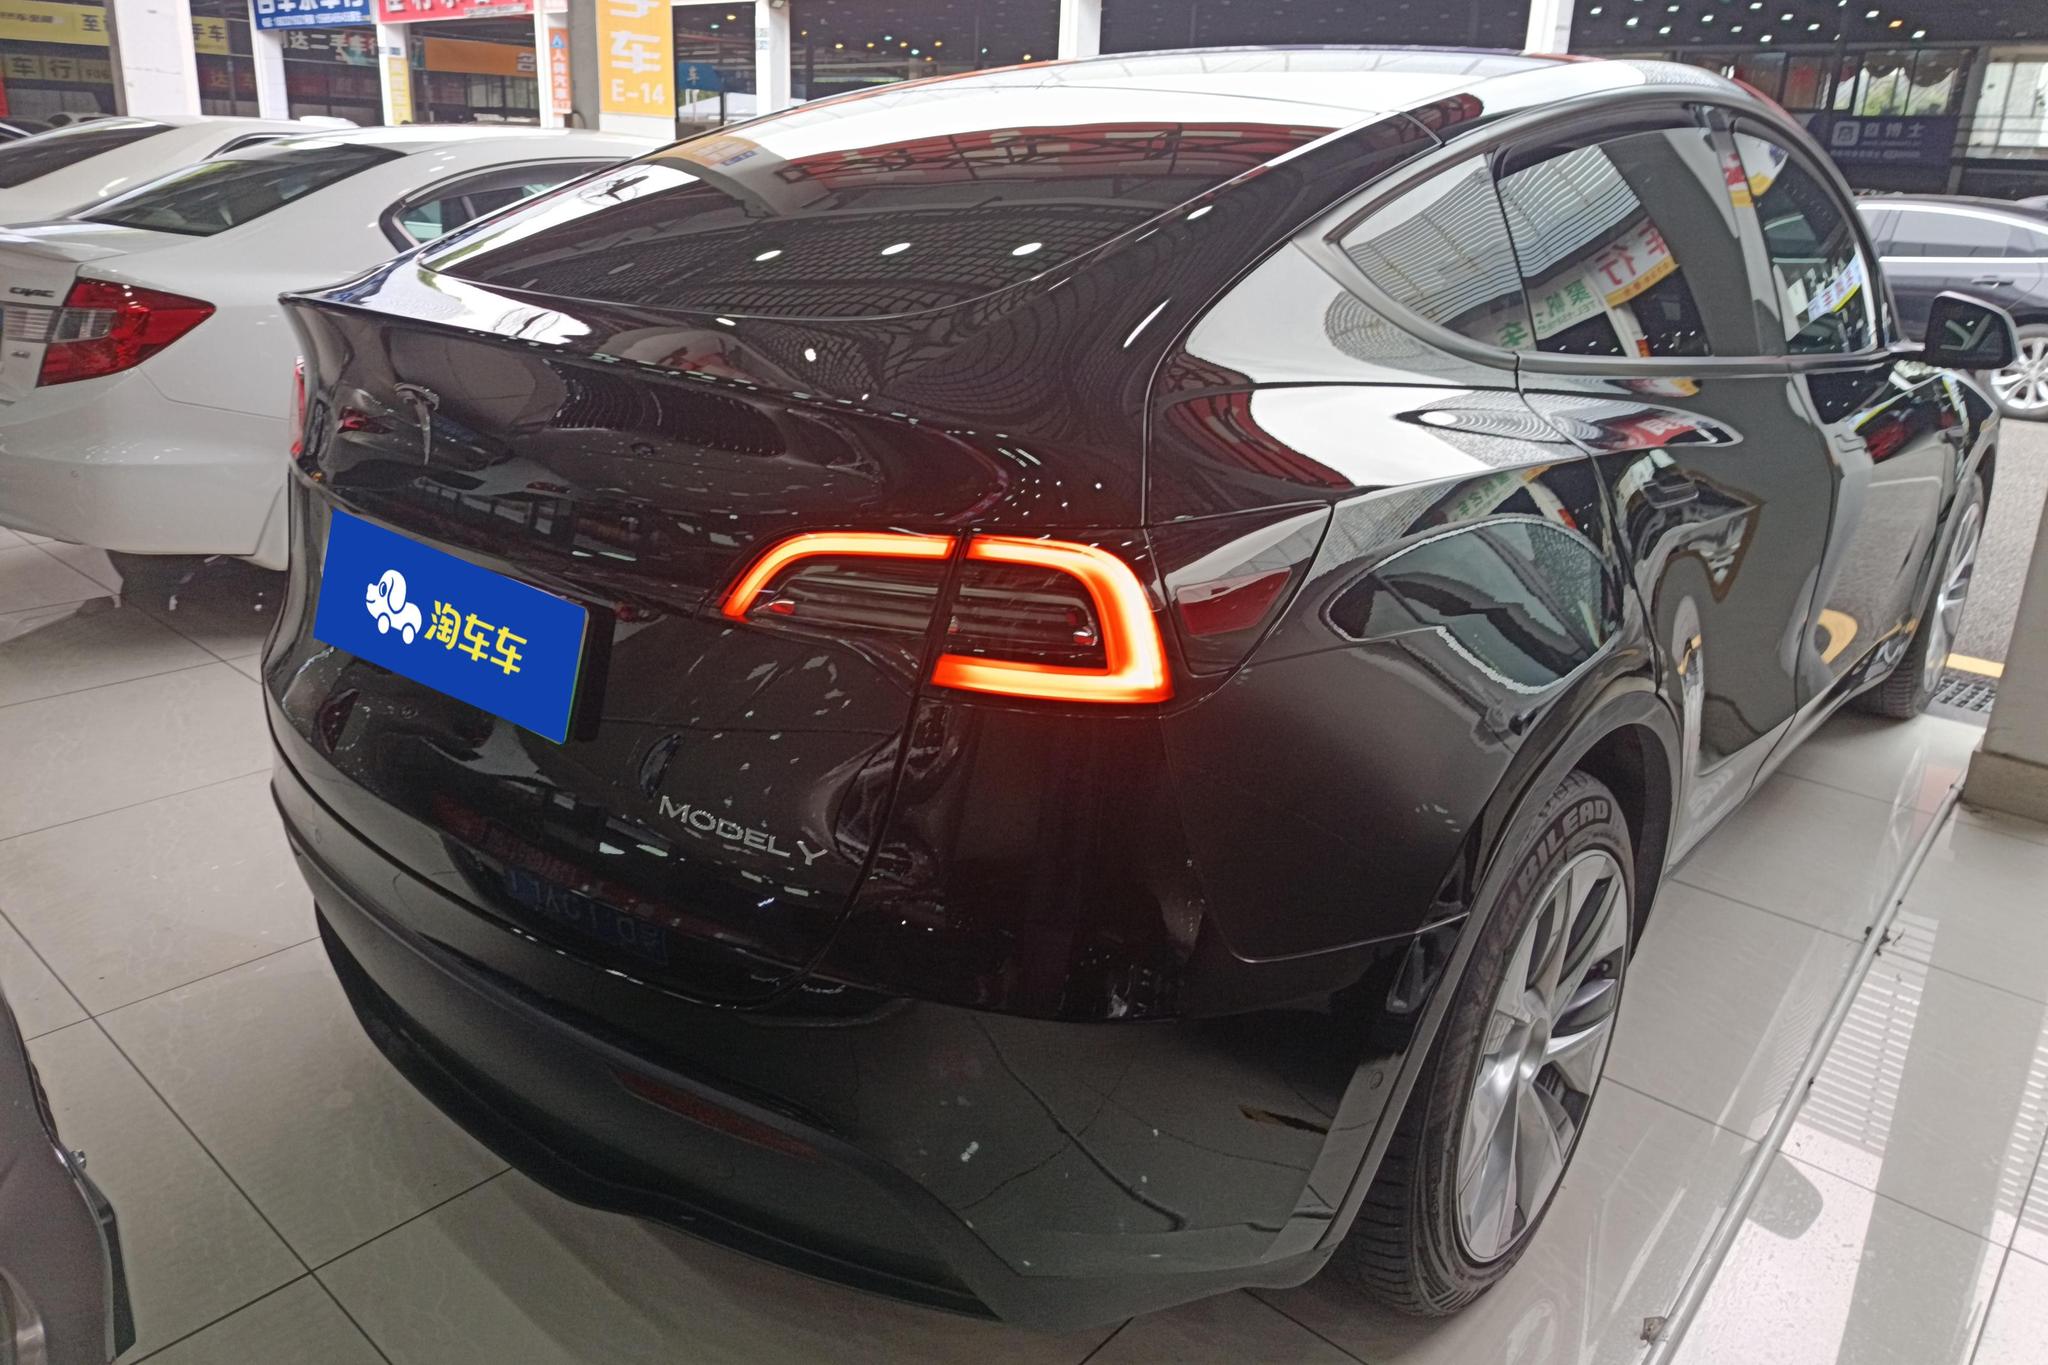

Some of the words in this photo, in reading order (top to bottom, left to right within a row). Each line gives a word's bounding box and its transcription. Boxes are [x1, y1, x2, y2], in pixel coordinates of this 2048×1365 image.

[611, 78, 666, 105] E-14
[659, 795, 791, 859] MODEL
[797, 840, 829, 866] Y
